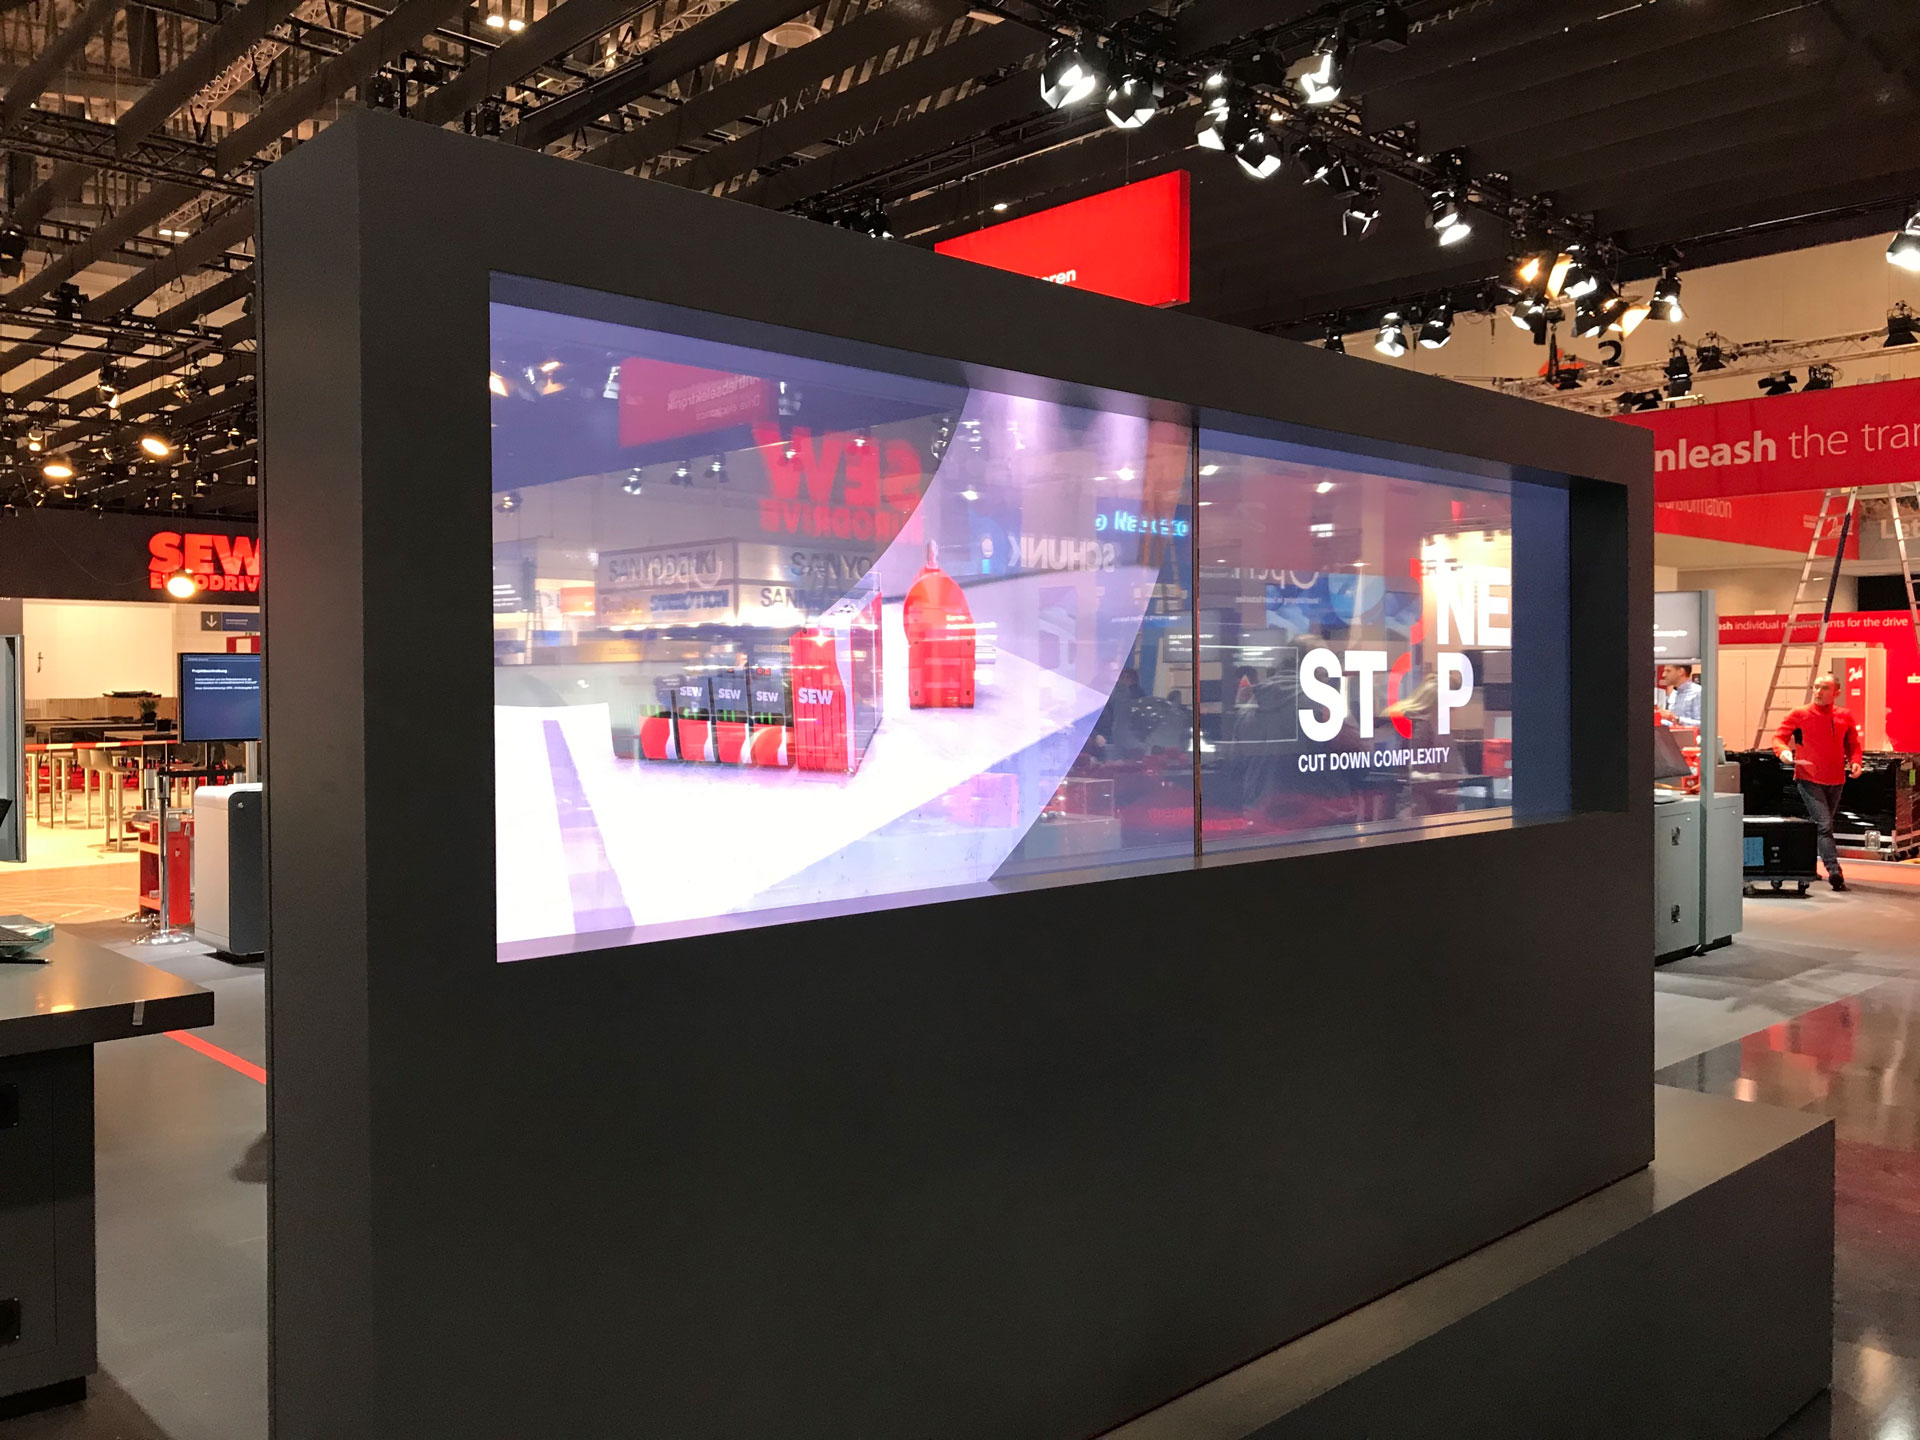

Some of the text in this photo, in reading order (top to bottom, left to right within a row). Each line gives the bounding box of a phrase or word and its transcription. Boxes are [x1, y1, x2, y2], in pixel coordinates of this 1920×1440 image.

[1788, 425, 1849, 460] the
[148, 531, 260, 576] SEW
[1735, 619, 1779, 630] individual
[1847, 617, 1862, 627] for
[1863, 617, 1880, 627] the
[1882, 616, 1908, 627] drive
[680, 686, 703, 697] SEW
[718, 688, 741, 700] SEW
[756, 690, 779, 702] SEW
[798, 687, 833, 705] SEW
[1298, 747, 1450, 772] CUT DOWN COMPLEXITY
